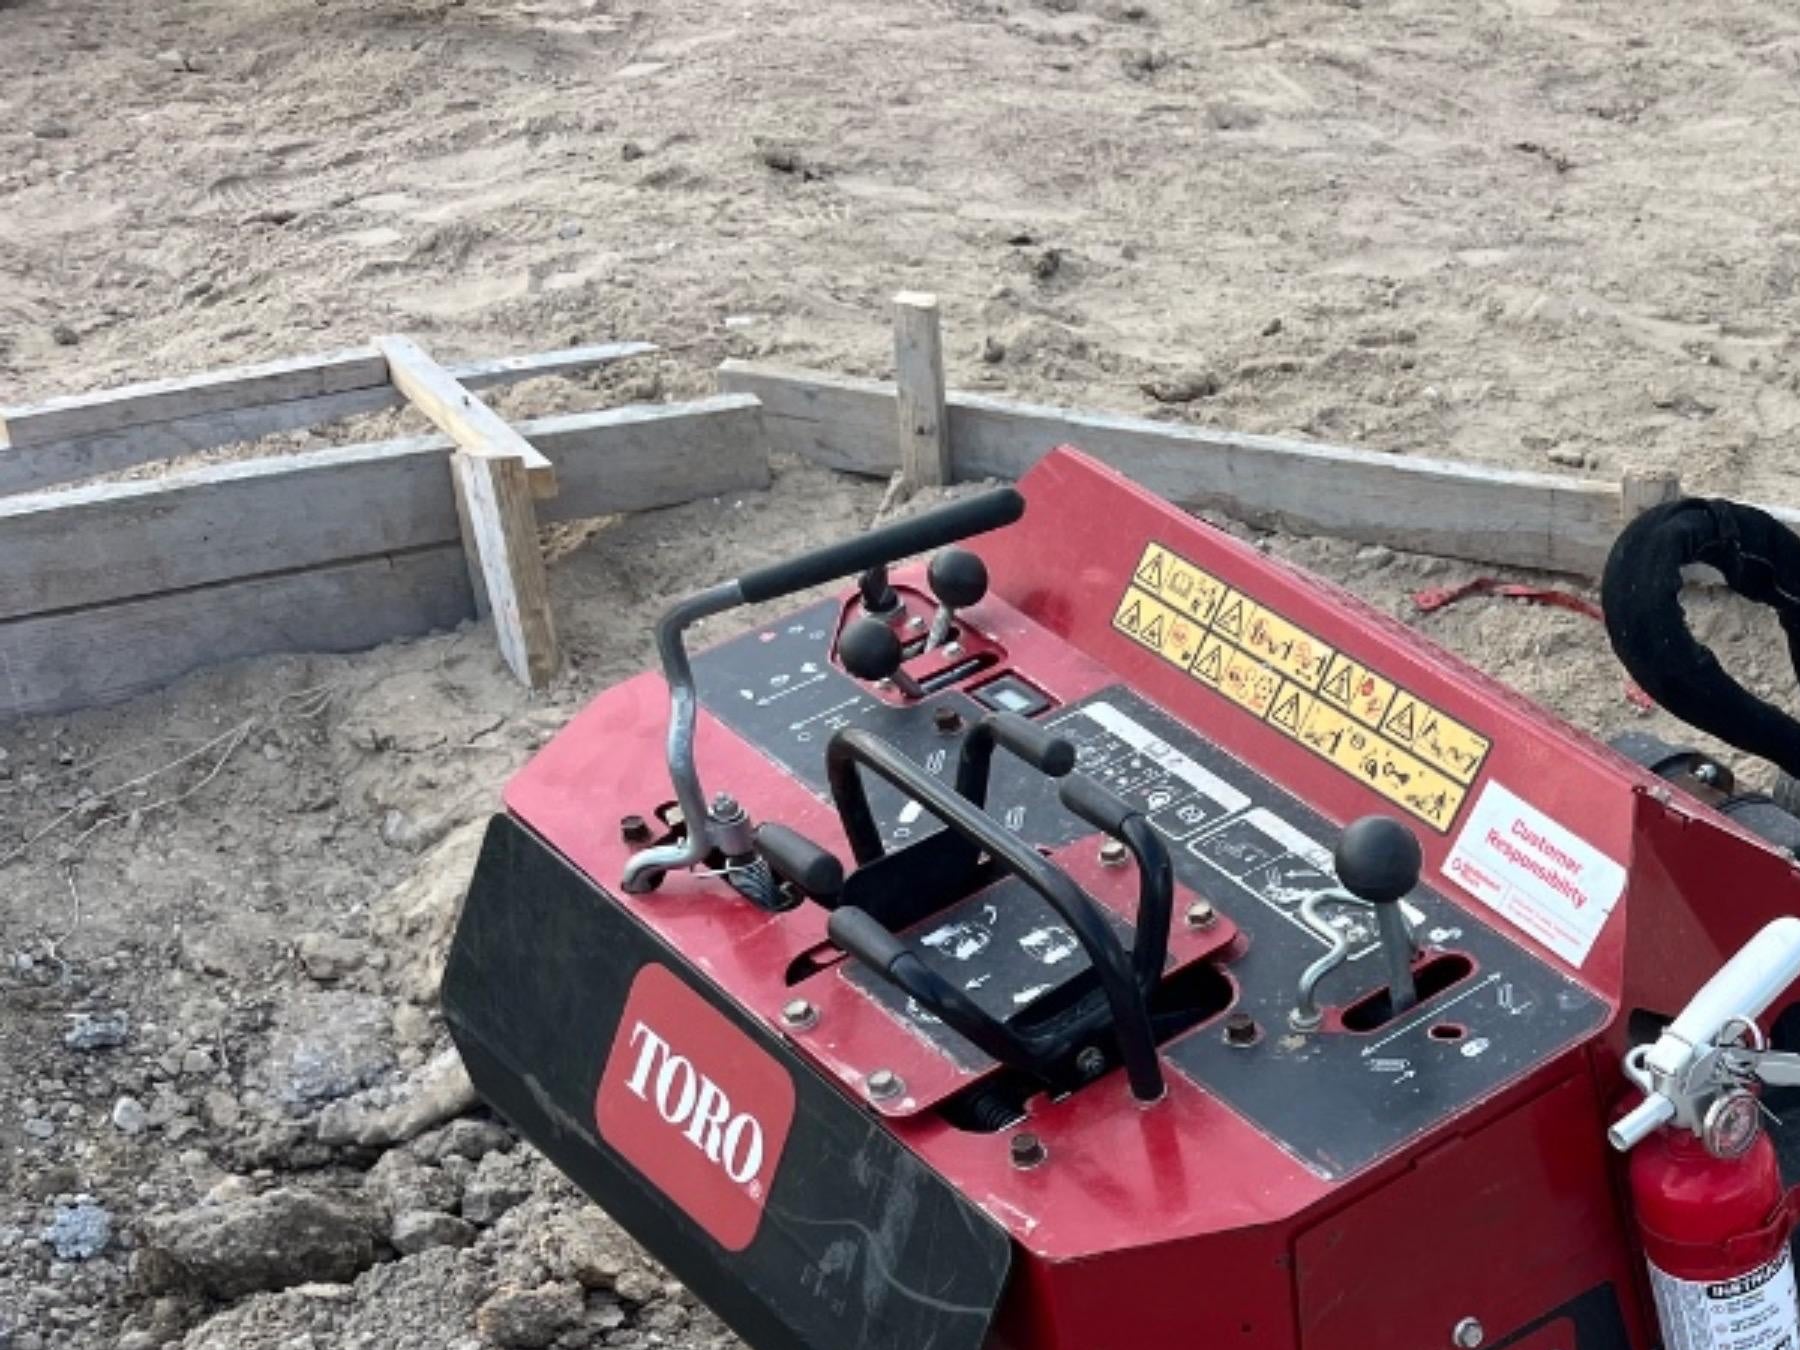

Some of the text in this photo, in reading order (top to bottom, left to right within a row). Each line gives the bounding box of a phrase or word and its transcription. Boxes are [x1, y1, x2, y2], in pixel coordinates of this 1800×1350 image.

[1485, 828, 1589, 910] Responsibility
[1511, 818, 1584, 876] Customer
[624, 1020, 764, 1184] TORO
